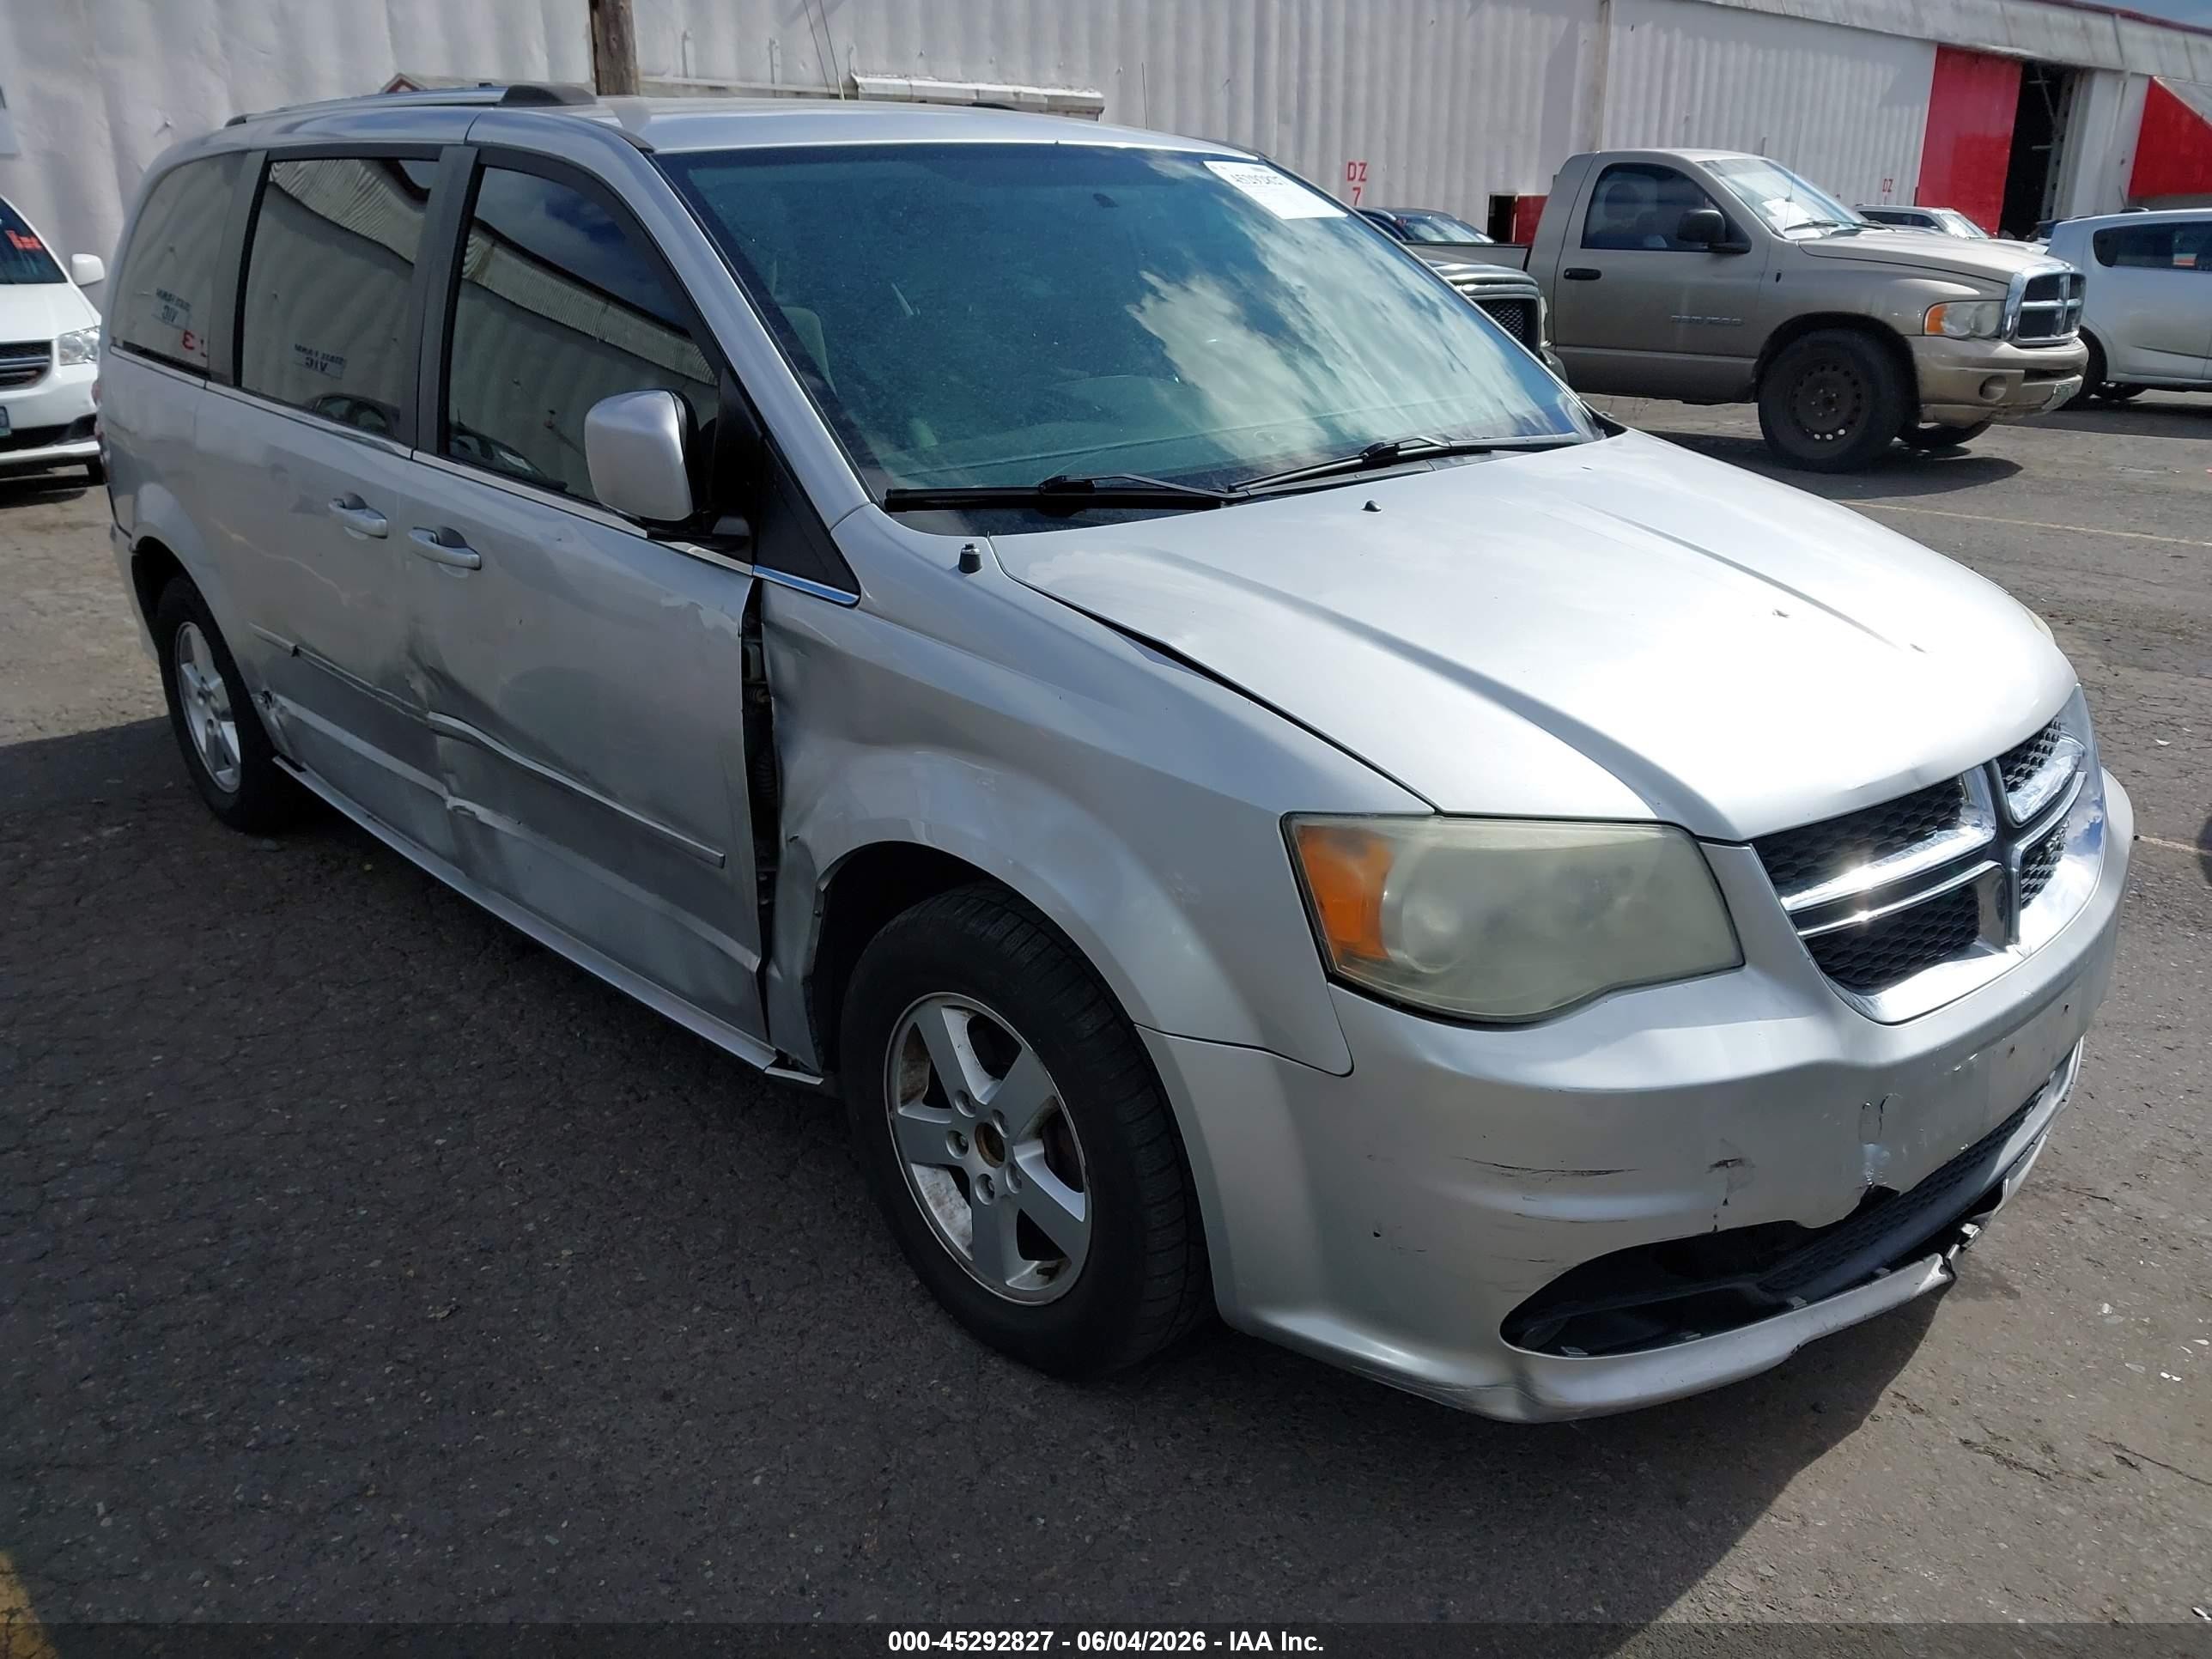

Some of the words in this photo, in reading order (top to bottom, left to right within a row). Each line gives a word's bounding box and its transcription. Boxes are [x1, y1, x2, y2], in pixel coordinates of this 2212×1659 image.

[1346, 161, 1368, 181] DZ
[1882, 178, 1893, 192] DZ
[1352, 186, 1361, 206] 7
